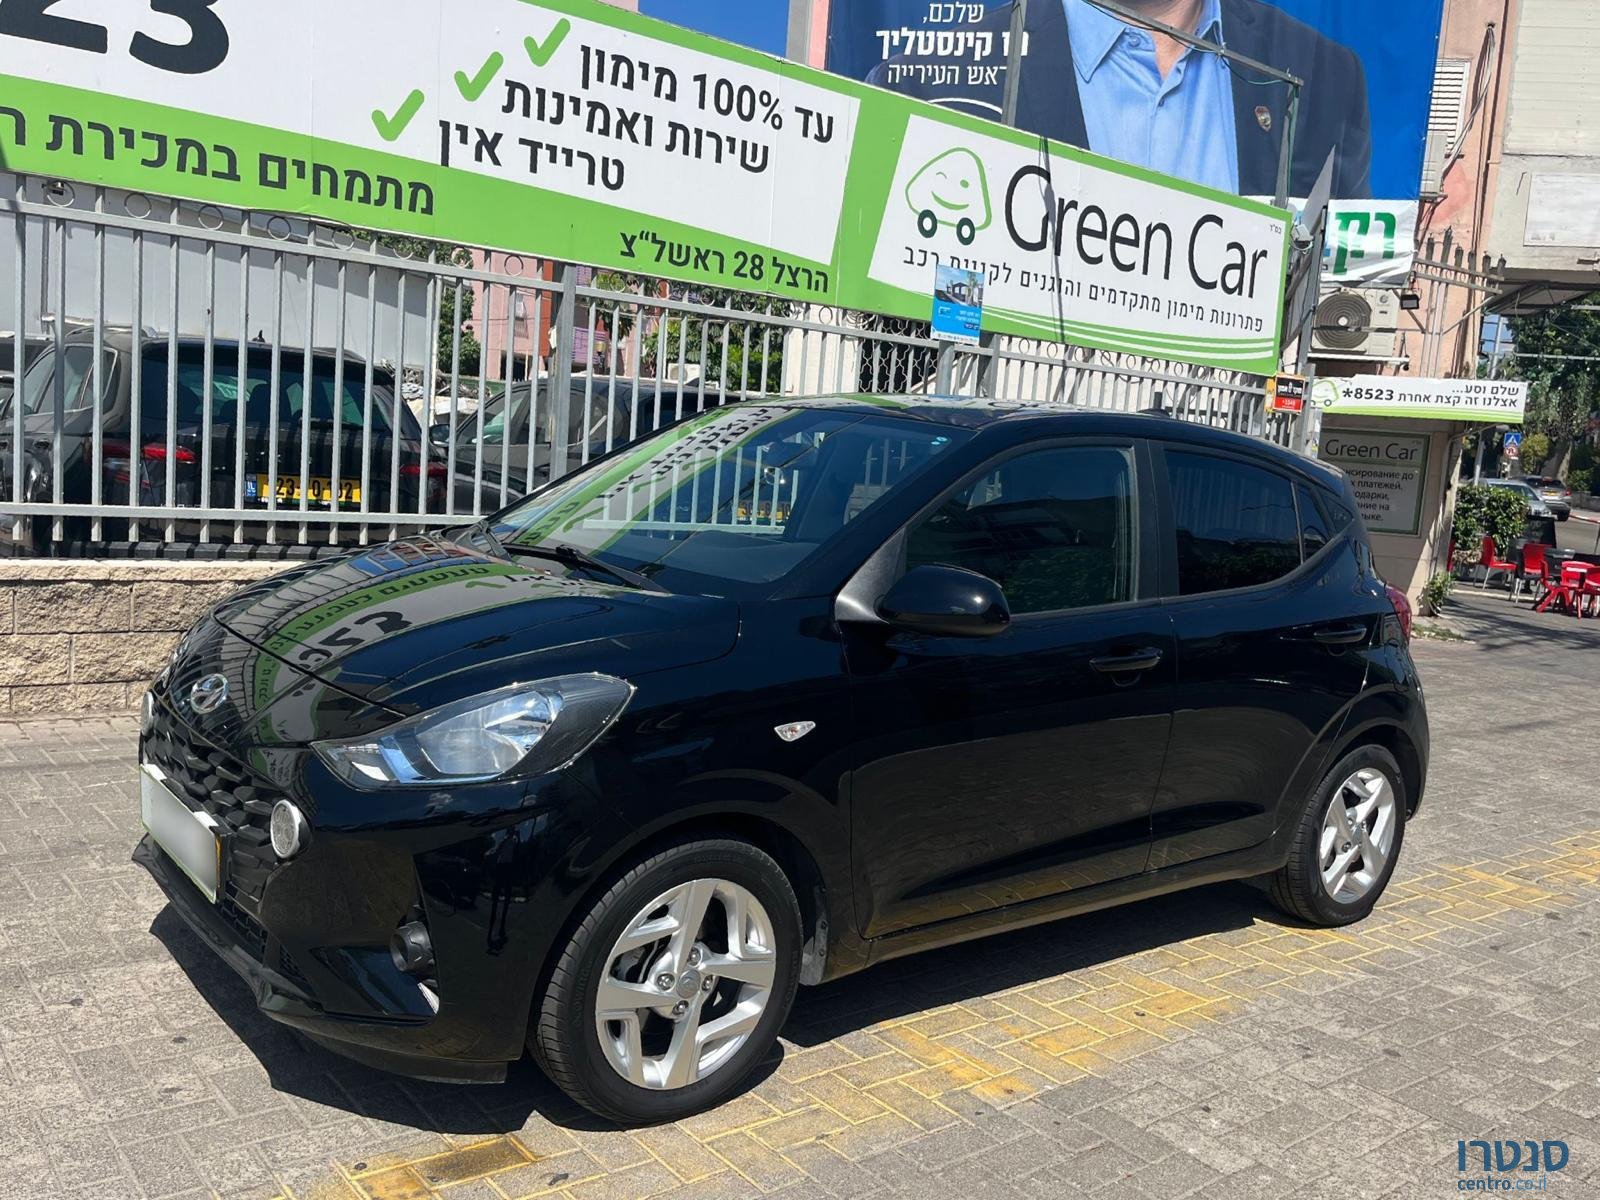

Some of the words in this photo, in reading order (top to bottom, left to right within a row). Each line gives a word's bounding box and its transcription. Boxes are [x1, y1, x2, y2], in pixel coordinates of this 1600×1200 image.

[923, 1, 985, 23] שלכם,
[875, 27, 993, 61] קינסטליך
[580, 44, 677, 103] מימון
[887, 64, 960, 85] העירייה
[501, 79, 653, 147] ואמינות
[693, 74, 783, 130] 100%
[795, 106, 834, 144] עד
[46, 114, 241, 182] במכירת
[439, 120, 503, 167] אין
[665, 121, 769, 173] שירות
[518, 137, 625, 191] טרייד
[259, 153, 434, 215] מתמחים
[1005, 165, 1173, 280] Green
[1188, 214, 1268, 299] Car
[1333, 212, 1397, 275] רק
[733, 251, 764, 281] 28
[772, 256, 829, 293] הרצל
[1020, 271, 1081, 298] והוגנים
[1088, 284, 1161, 312] מתקדמים
[1167, 299, 1204, 320] מימון
[1209, 308, 1263, 333] פתרונות
[1398, 393, 1431, 404] אחרת
[1435, 395, 1460, 407] קצת
[1464, 396, 1478, 406] זה
[1483, 395, 1518, 408] אצלנו
[1490, 384, 1520, 397] שלם
[1325, 439, 1380, 458] Green
[1385, 443, 1418, 460] Car
[1401, 471, 1414, 481] до
